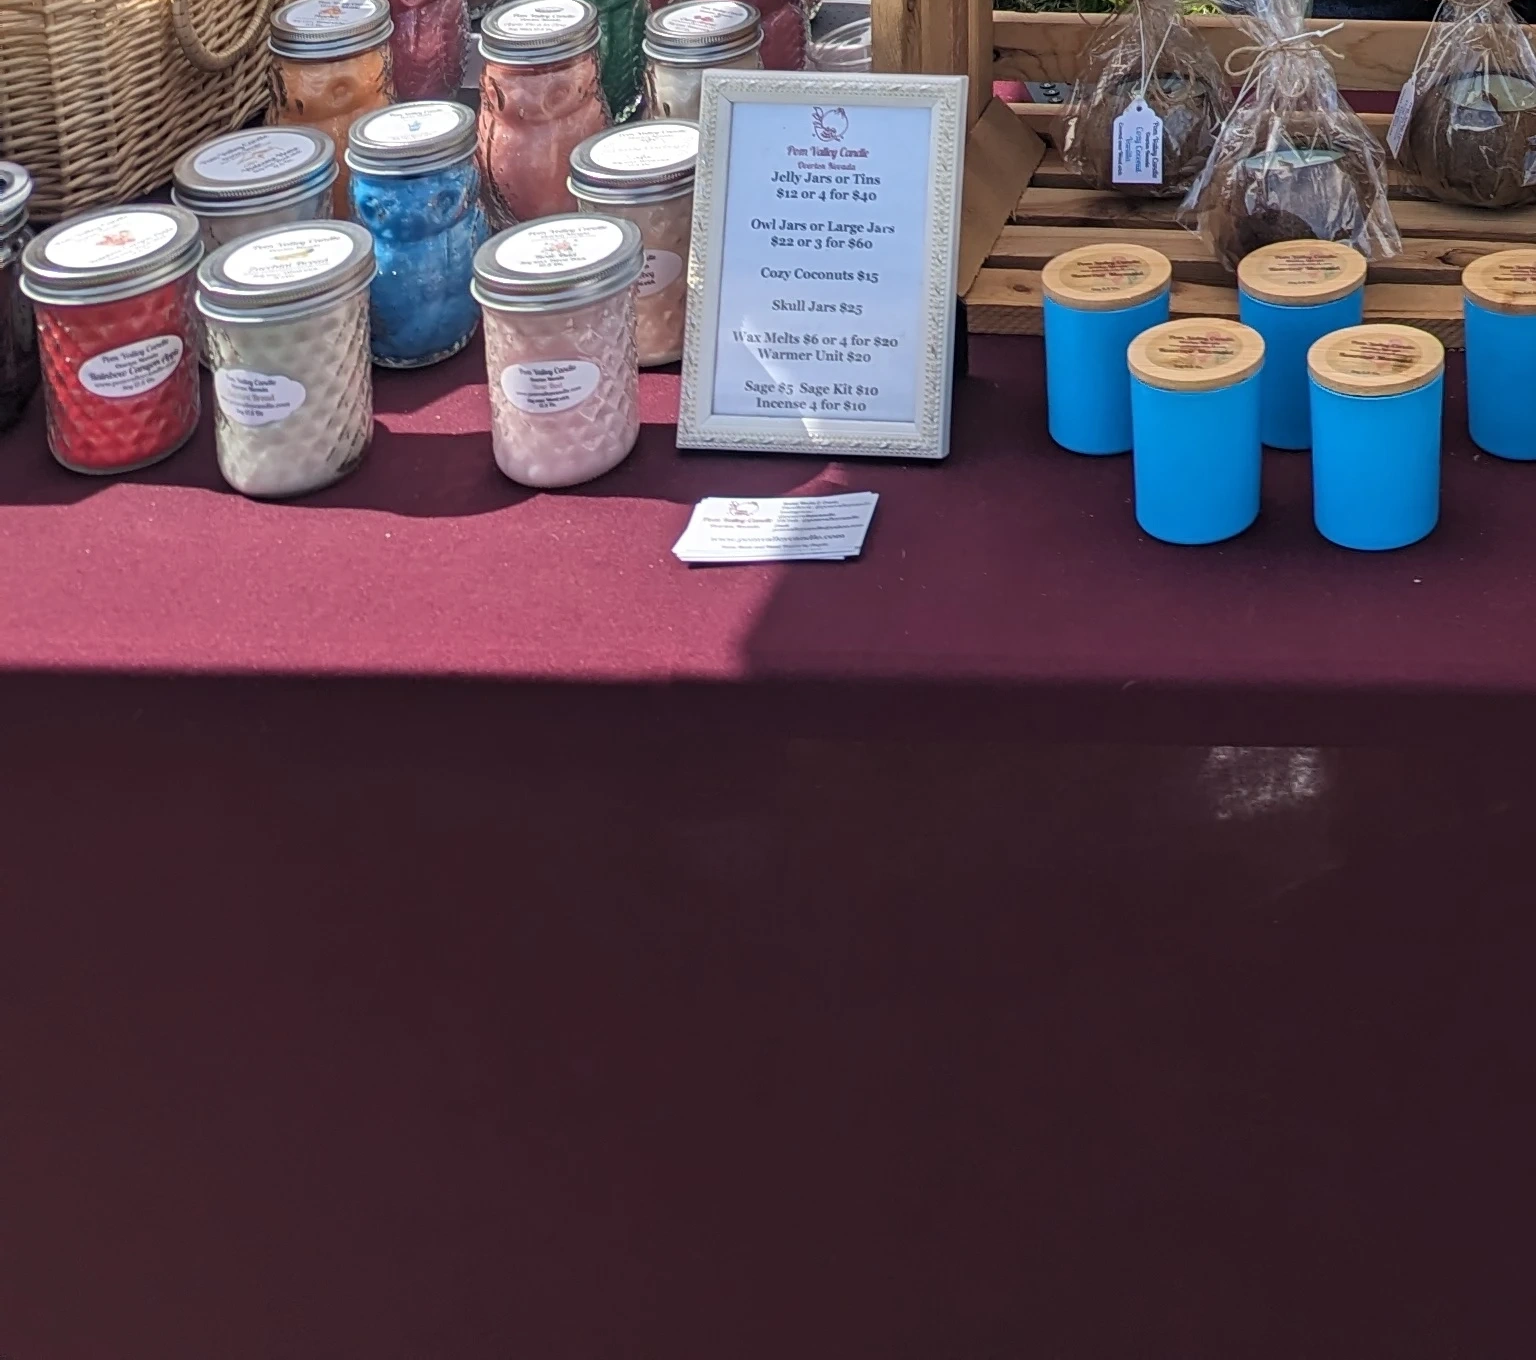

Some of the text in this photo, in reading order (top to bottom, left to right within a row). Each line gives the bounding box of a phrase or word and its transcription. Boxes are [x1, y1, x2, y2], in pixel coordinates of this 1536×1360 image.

[787, 145, 870, 160] Pom Valley Candle
[771, 171, 881, 185] Jelly Jars or Tins
[777, 188, 877, 202] $12 or 4 for $40
[751, 219, 895, 235] Owl Jars or Large Jars
[771, 236, 872, 250] $22 or 3 for $60
[761, 267, 879, 283] Cozy Coconuts $15
[772, 300, 863, 315] Skull Jars $25
[732, 331, 898, 348] Wax Melts $6 or 4 for $20
[758, 348, 871, 363] Warmer Unit $20
[745, 380, 879, 396] Sage $5 Sage Kit $10
[756, 397, 866, 412] Incense 4 for $10
